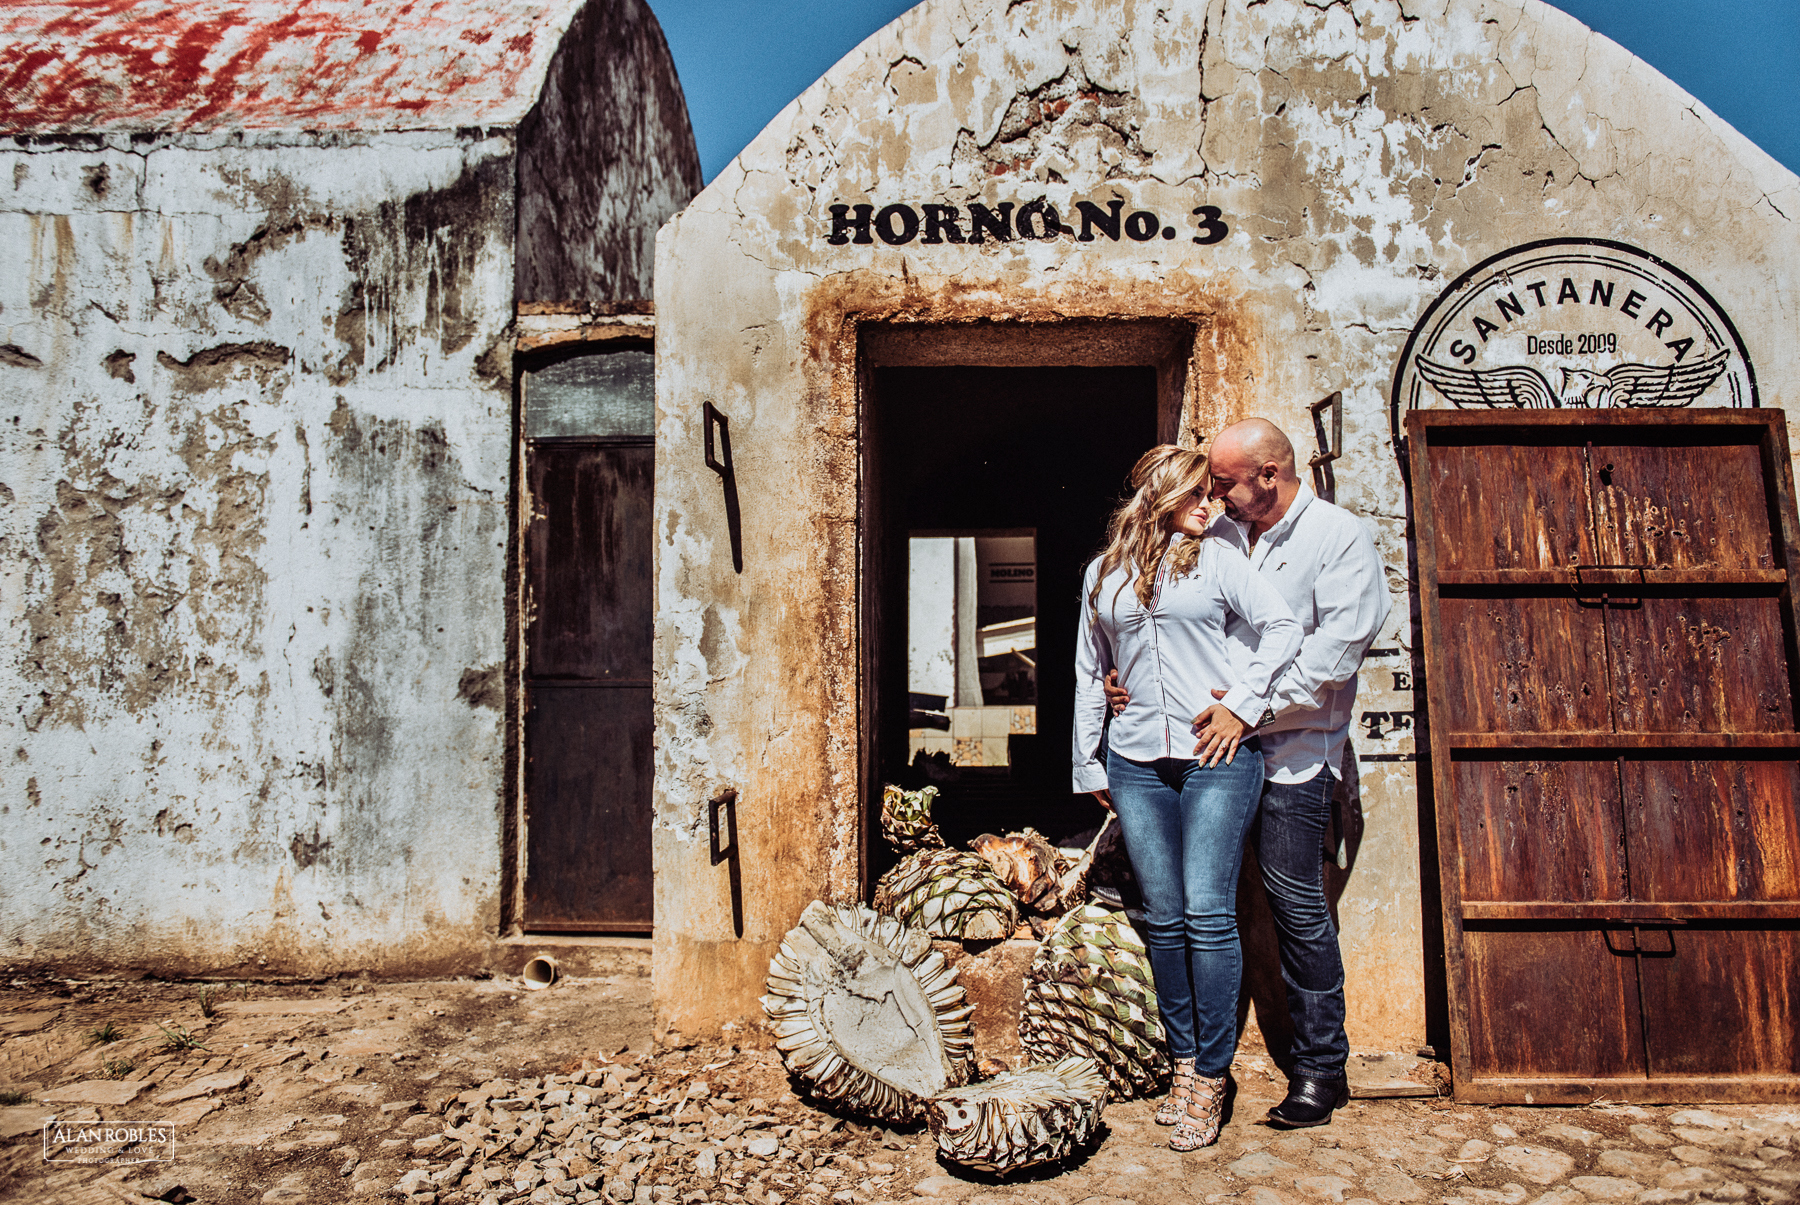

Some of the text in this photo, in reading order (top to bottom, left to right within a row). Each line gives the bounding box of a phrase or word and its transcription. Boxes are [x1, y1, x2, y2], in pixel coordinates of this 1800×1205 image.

[827, 200, 1229, 245] HORNO No. 3
[1450, 277, 1695, 364] SANTANERA
[1527, 333, 1617, 355] Desde 2009
[991, 568, 1034, 577] MOLINO
